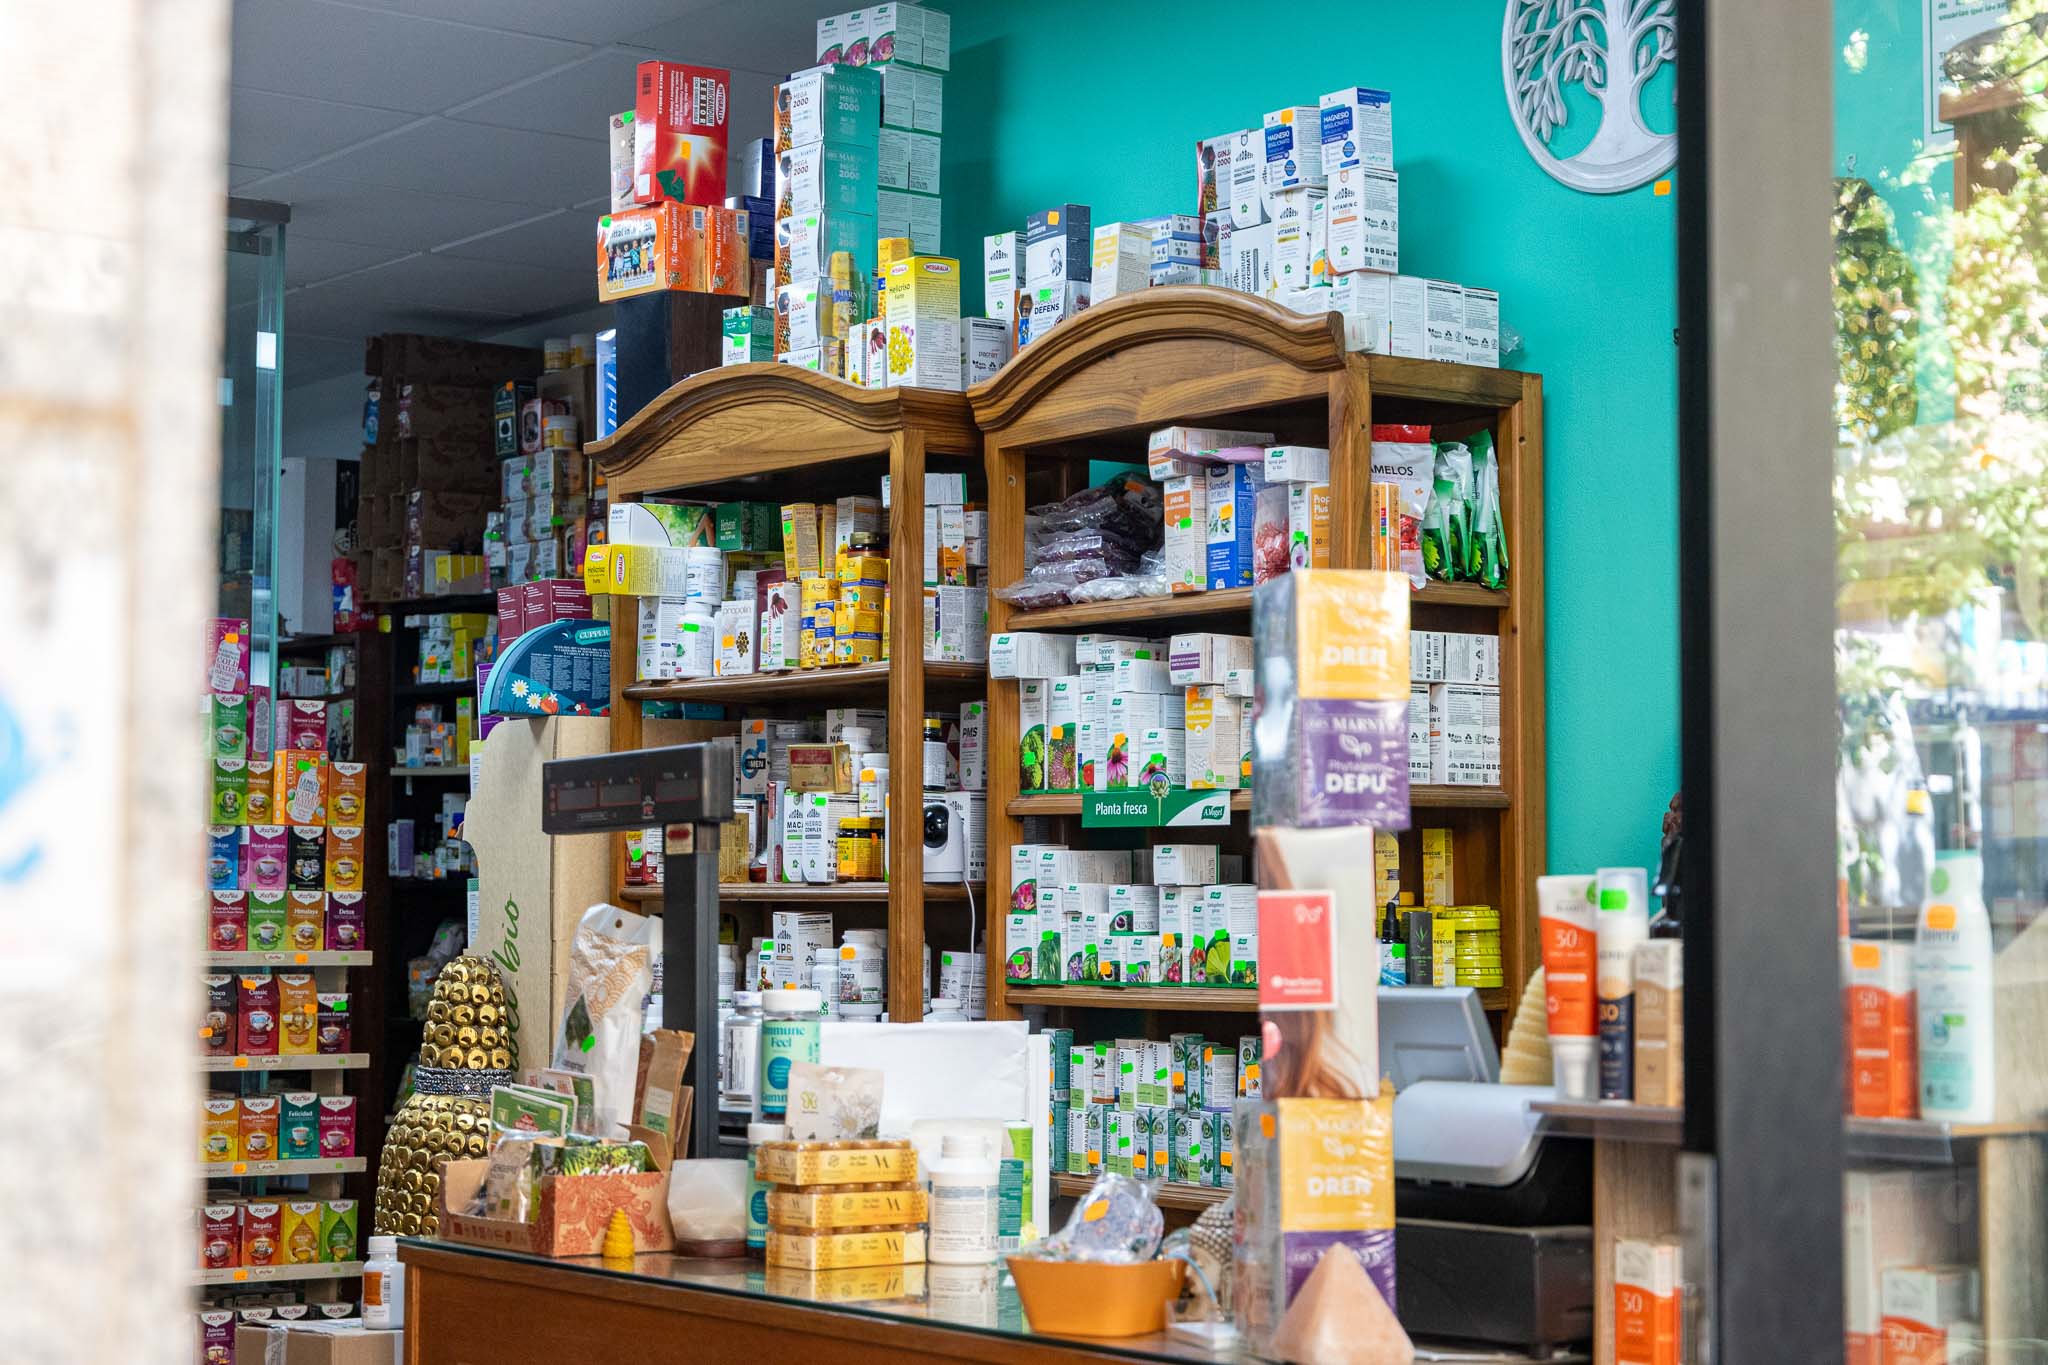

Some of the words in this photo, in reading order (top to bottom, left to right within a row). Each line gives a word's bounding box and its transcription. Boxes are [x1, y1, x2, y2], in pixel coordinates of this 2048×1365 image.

[793, 97, 809, 108] 2000
[839, 102, 859, 112] 2000
[1322, 111, 1350, 123] MAGNESIO
[1267, 131, 1290, 143] MAGNESIO
[793, 166, 808, 176] 2000
[1332, 203, 1352, 212] VITAMIN
[1034, 303, 1060, 315] DEFENS
[962, 728, 978, 737] PMS
[750, 759, 765, 769] MEN
[1095, 802, 1121, 815] Planta
[1123, 802, 1148, 815] fresca
[1204, 806, 1223, 817] A.Vogel
[294, 908, 319, 917] Himalaya
[338, 908, 355, 916] Detox
[491, 893, 521, 973] bio
[777, 943, 792, 954] IP6
[207, 990, 227, 998] Choco
[248, 989, 269, 997] Classic
[762, 1027, 806, 1036] mmune
[770, 1036, 792, 1048] Feel
[288, 1110, 314, 1118] Felicidad
[253, 1222, 272, 1230] Regaliz
